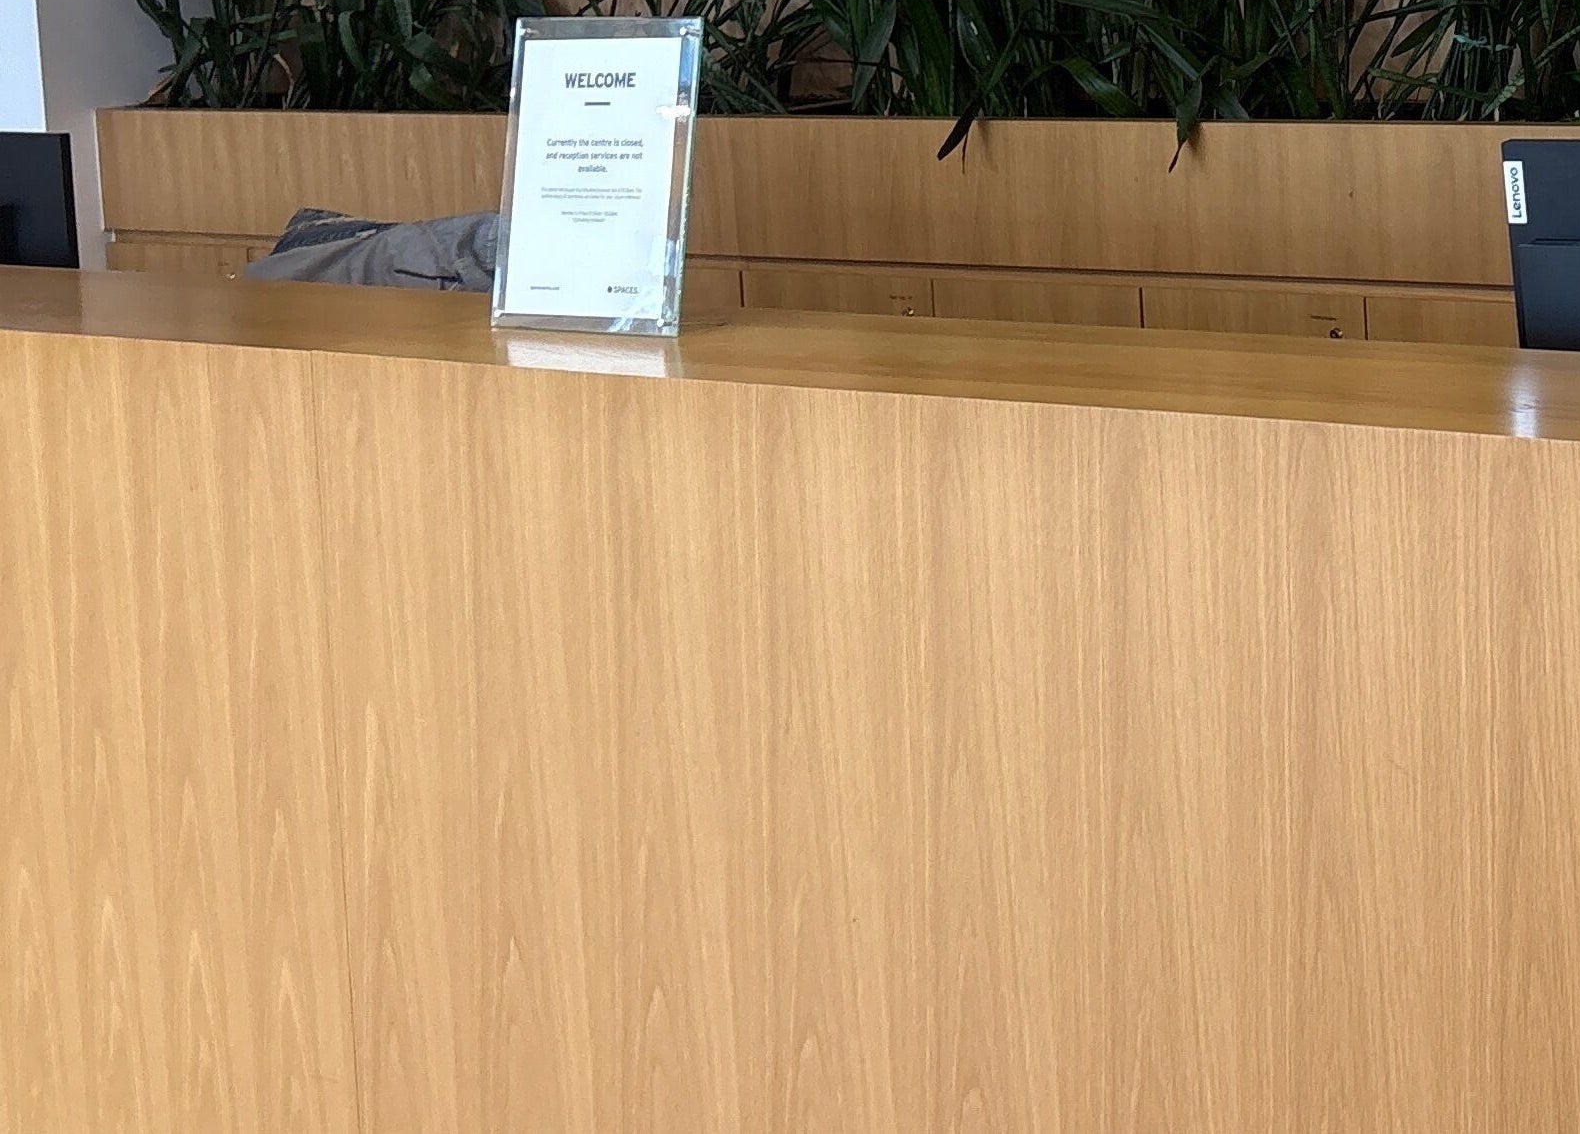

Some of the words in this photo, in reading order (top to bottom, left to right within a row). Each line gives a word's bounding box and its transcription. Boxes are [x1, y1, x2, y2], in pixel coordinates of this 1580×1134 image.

[565, 72, 636, 88] WELCOME
[546, 138, 577, 148] Currently
[579, 138, 589, 147] the
[591, 138, 612, 147] centre
[613, 138, 619, 147] is
[621, 138, 644, 147] closed,
[545, 152, 558, 160] and
[559, 152, 589, 161] reception
[590, 152, 617, 160] services
[631, 152, 643, 160] not
[1510, 167, 1522, 218] Lenovo
